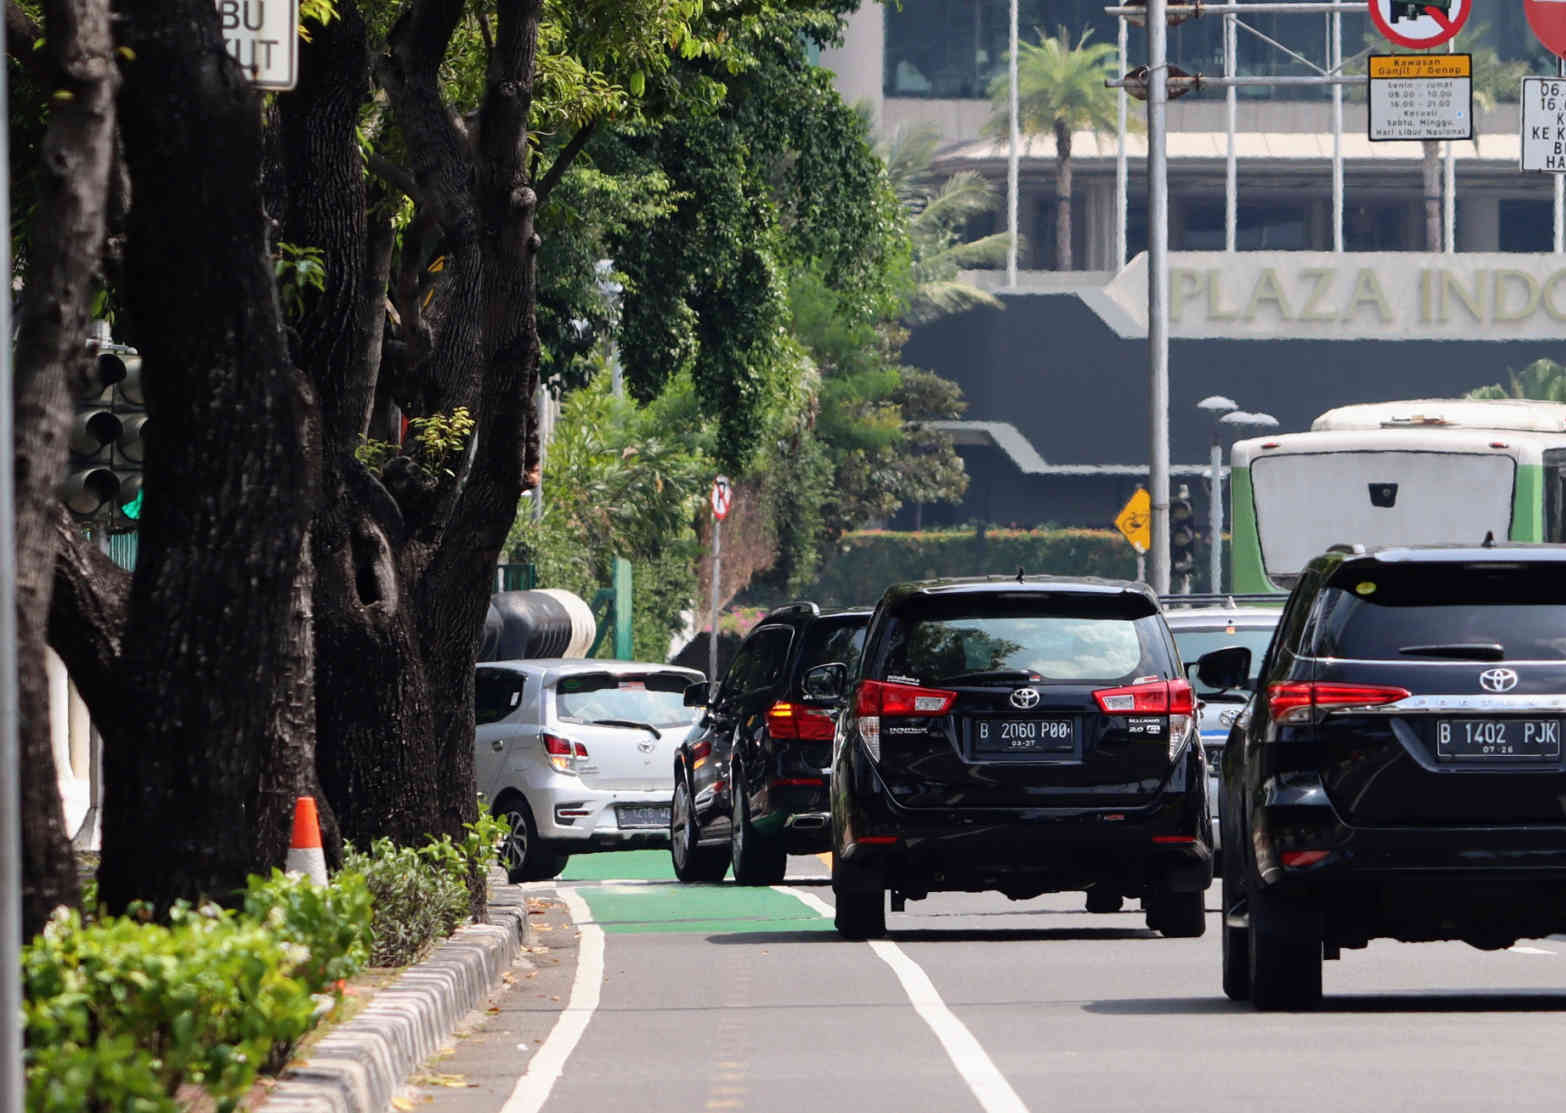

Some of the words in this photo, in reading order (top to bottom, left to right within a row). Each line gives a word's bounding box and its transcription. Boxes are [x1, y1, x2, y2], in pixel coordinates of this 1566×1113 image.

[1532, 127, 1549, 139] KE
[1168, 268, 1394, 322] PLAZA
[979, 723, 989, 739] B
[1001, 722, 1036, 739] 2060
[1440, 723, 1451, 744] B
[1465, 723, 1506, 744] 1402
[1524, 722, 1556, 744] PJK
